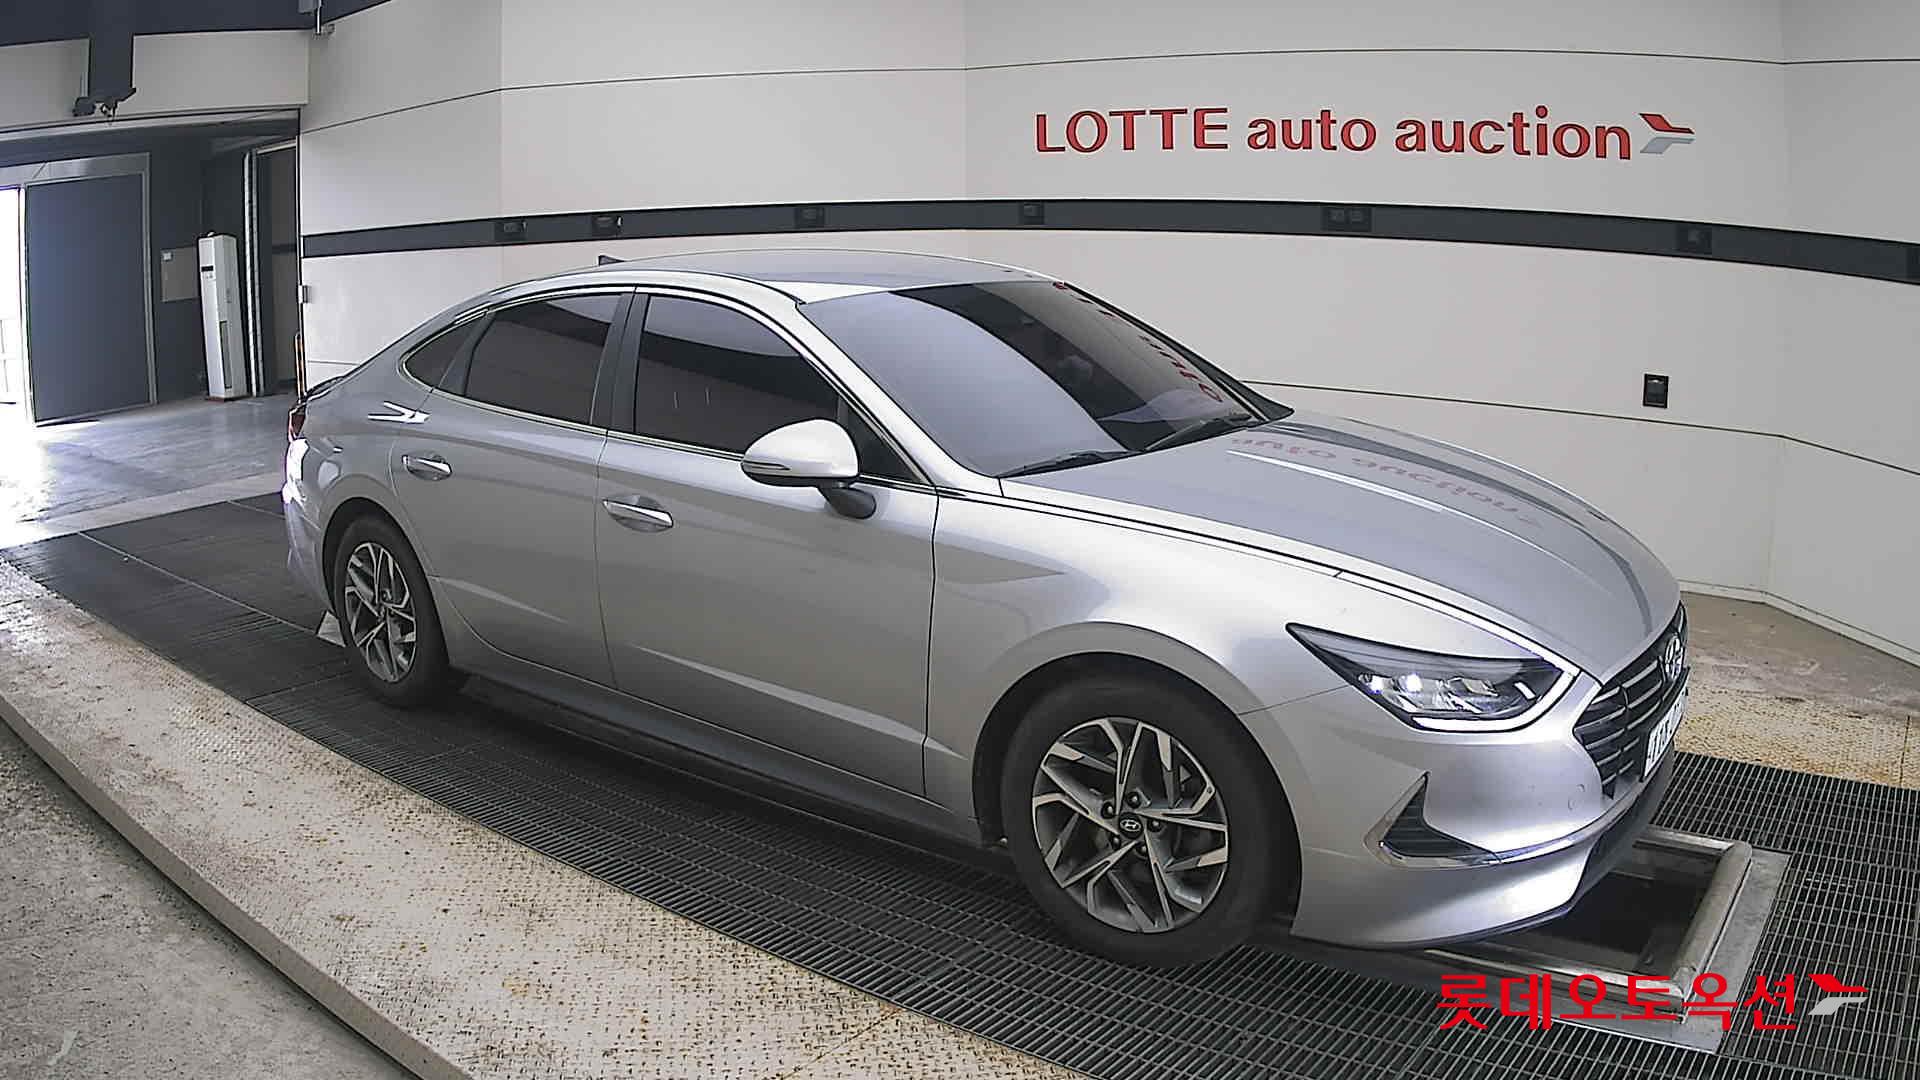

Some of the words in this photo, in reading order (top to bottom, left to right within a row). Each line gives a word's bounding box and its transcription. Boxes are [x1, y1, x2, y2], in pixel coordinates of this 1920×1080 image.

[1035, 107, 1229, 154] LOTTE
[1247, 109, 1378, 152] auto
[1394, 105, 1632, 160] auction
